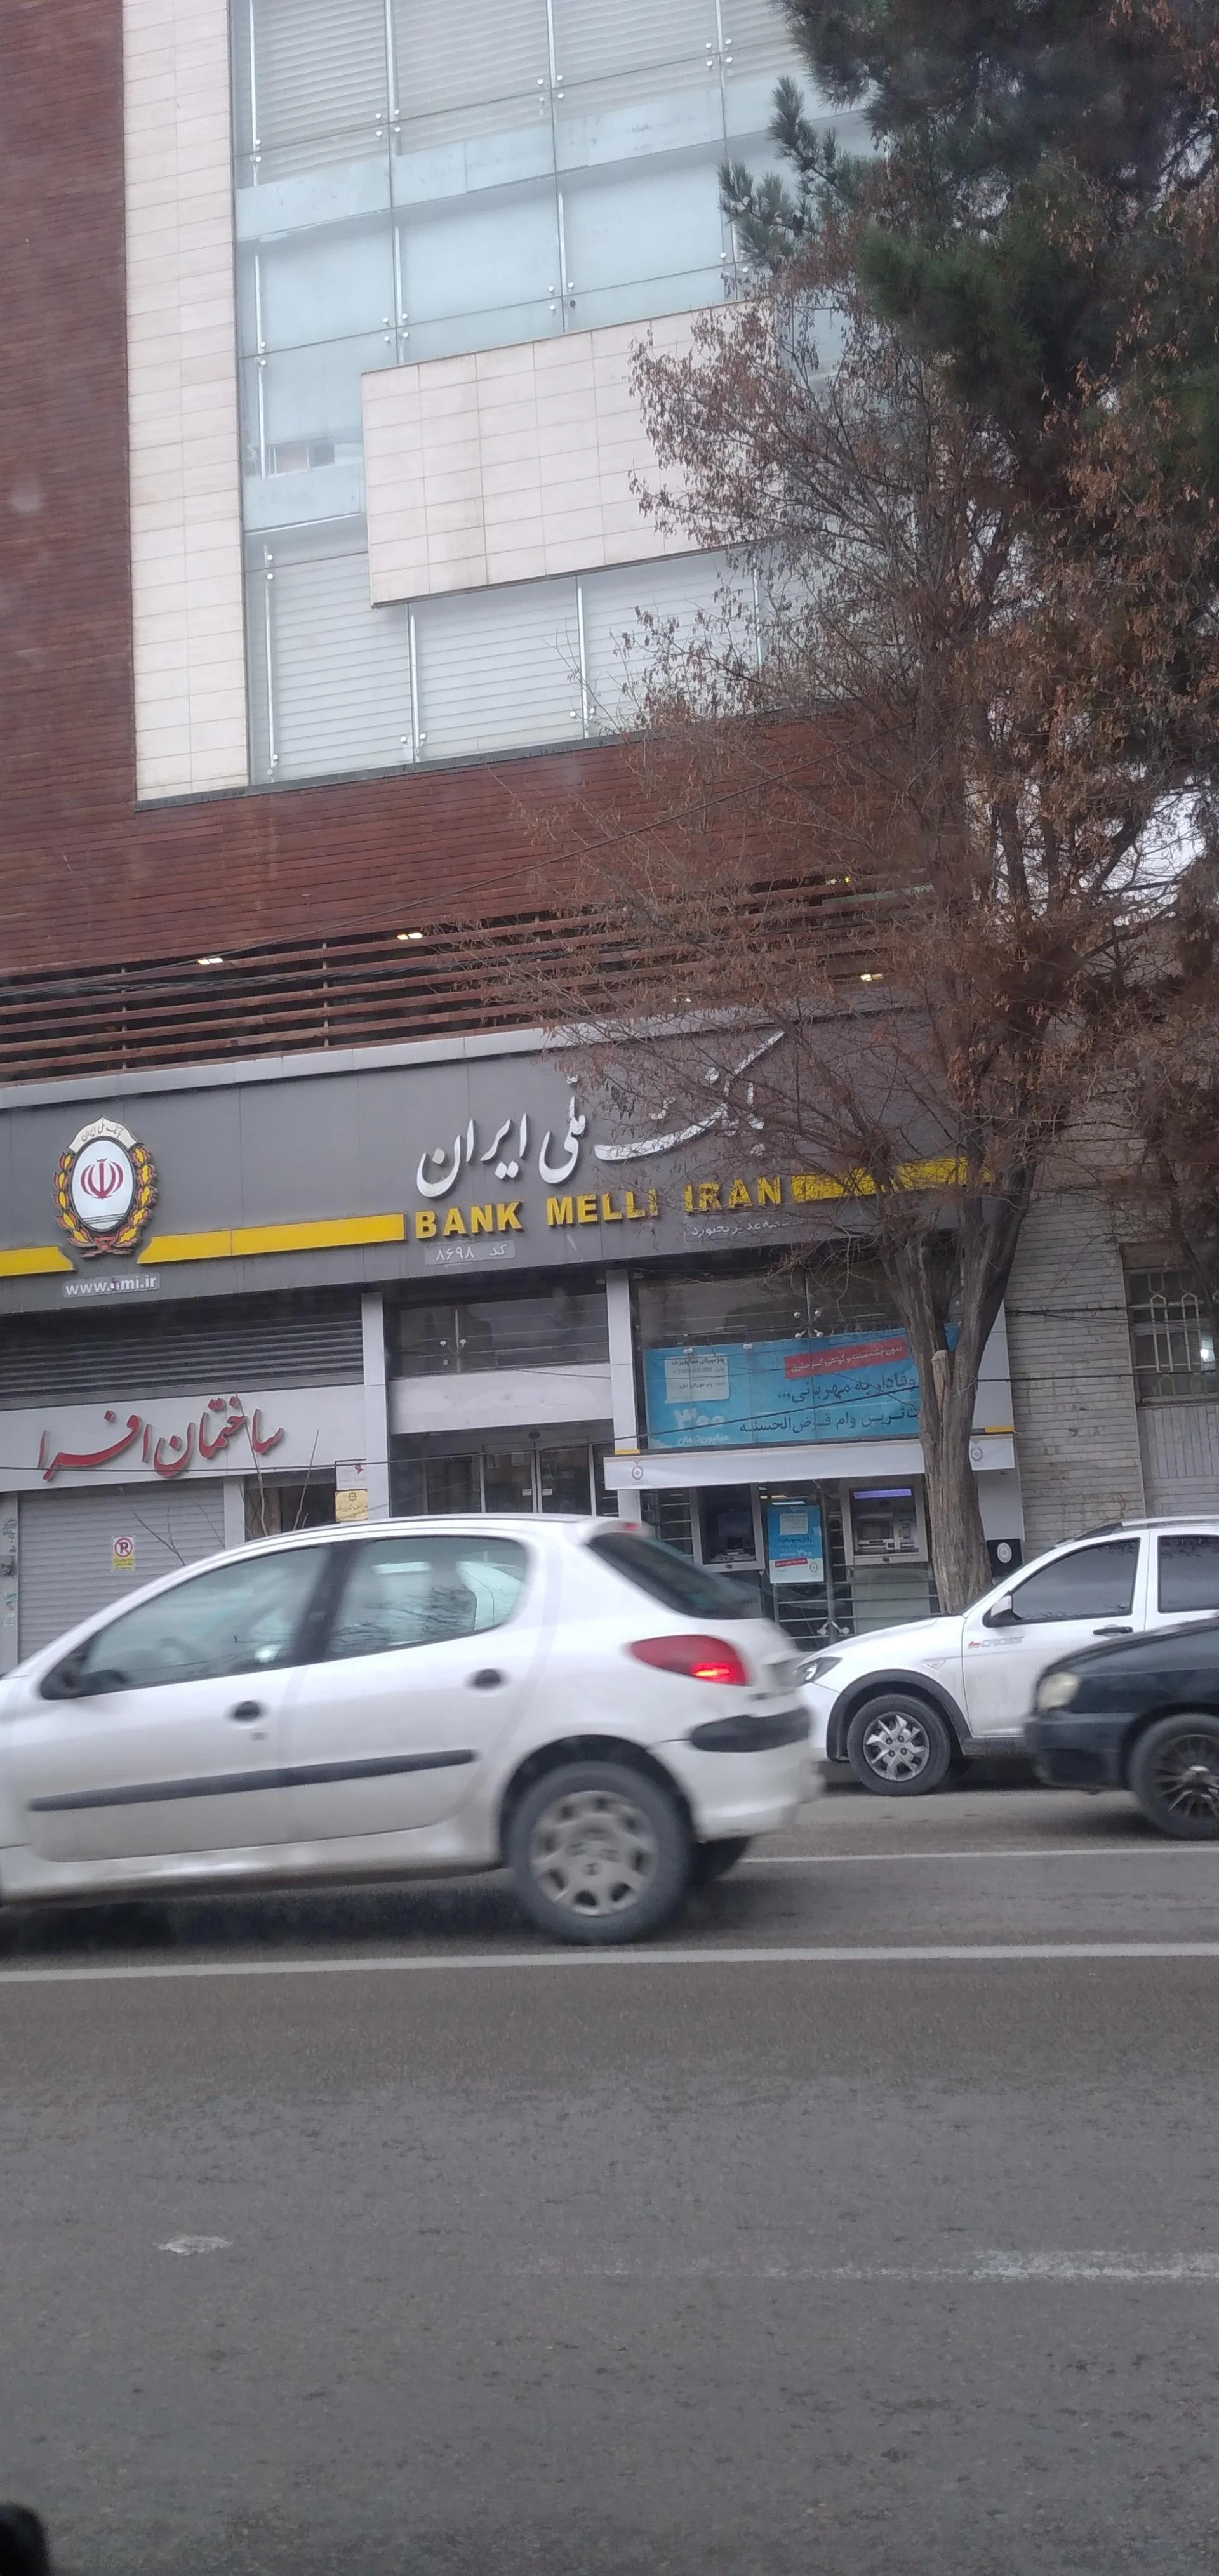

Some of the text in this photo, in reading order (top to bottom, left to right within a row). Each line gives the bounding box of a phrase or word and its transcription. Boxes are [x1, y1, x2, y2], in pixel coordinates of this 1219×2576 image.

[416, 1112, 527, 1197] ایران
[415, 1176, 782, 1239] BANK MELLI IRAN
[435, 1244, 508, 1261] کد ۸۶۹۸
[855, 1380, 870, 1395] به
[37, 1396, 285, 1482] ساختمان افرا
[836, 1412, 856, 1429] وام
